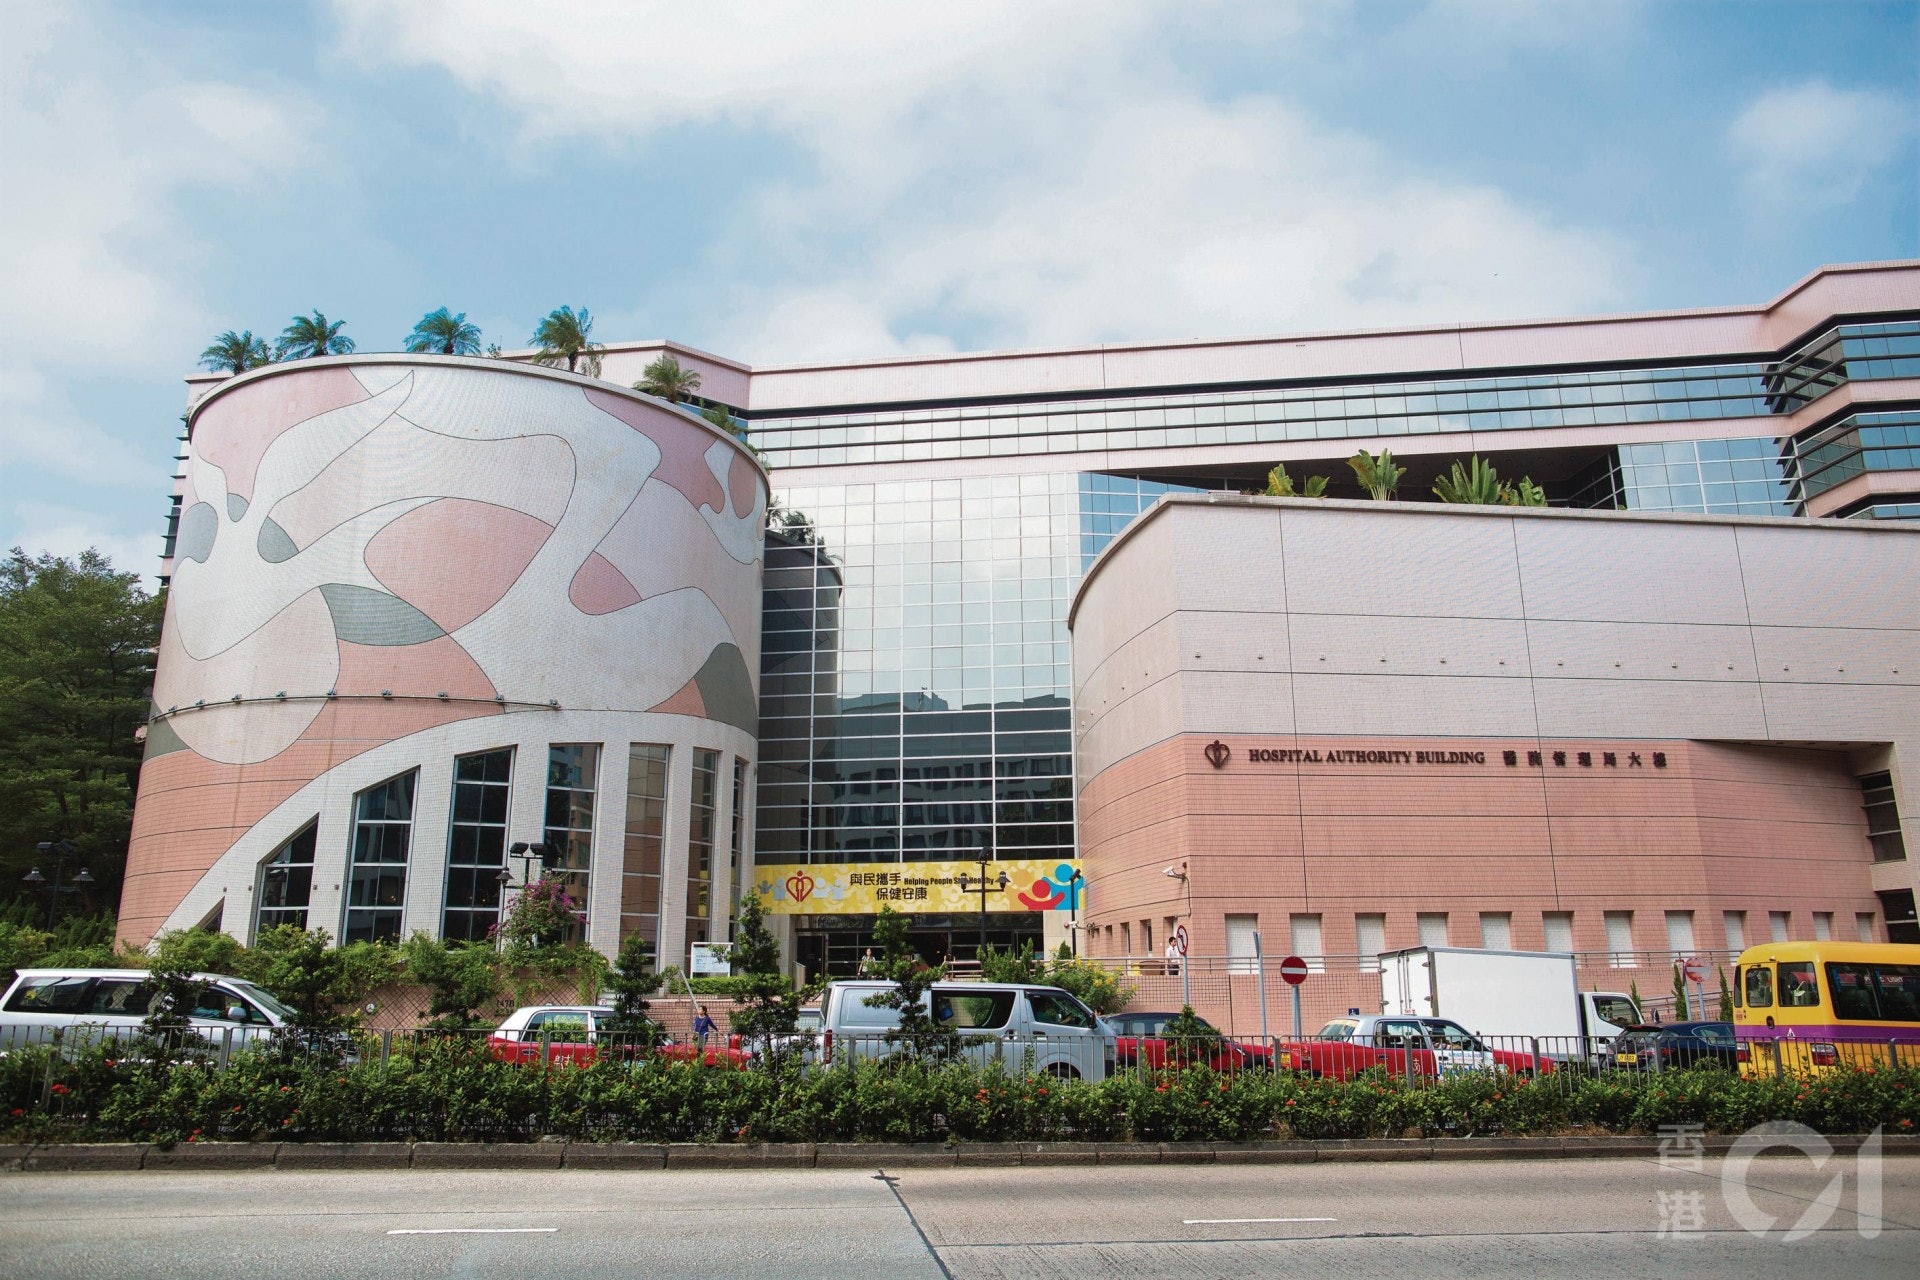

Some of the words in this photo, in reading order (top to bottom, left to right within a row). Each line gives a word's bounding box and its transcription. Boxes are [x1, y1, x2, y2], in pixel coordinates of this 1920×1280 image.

[1249, 749, 1323, 763] HOSPITAL
[1326, 750, 1411, 764] AUTHORITY
[1416, 751, 1485, 765] BUILDING
[850, 872, 901, 886] 與民攜手
[904, 878, 929, 886] Helping
[930, 877, 952, 885] People
[876, 887, 928, 901] 保健安康
